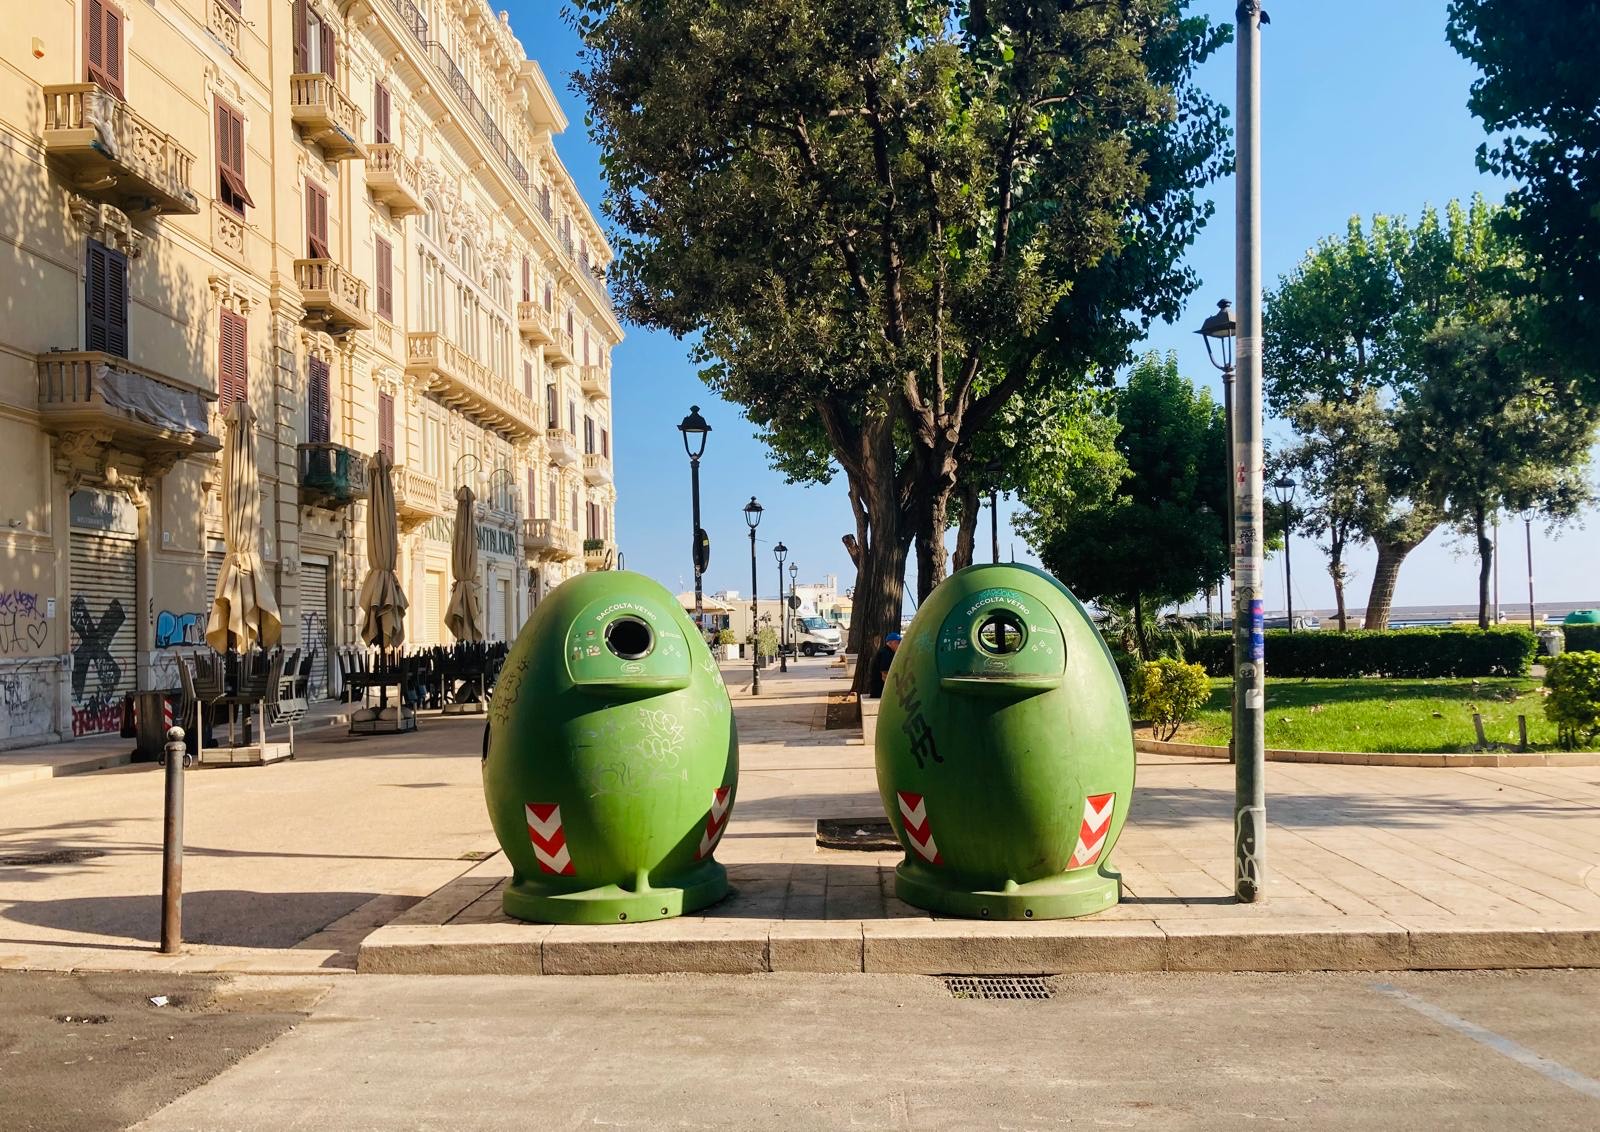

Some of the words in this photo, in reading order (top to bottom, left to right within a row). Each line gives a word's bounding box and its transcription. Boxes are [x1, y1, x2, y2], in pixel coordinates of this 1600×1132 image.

[596, 602, 633, 621] RACCOLTA
[634, 604, 657, 620] VETRO
[966, 597, 1005, 616] RACCOLTA
[1006, 599, 1030, 615] VETRO
